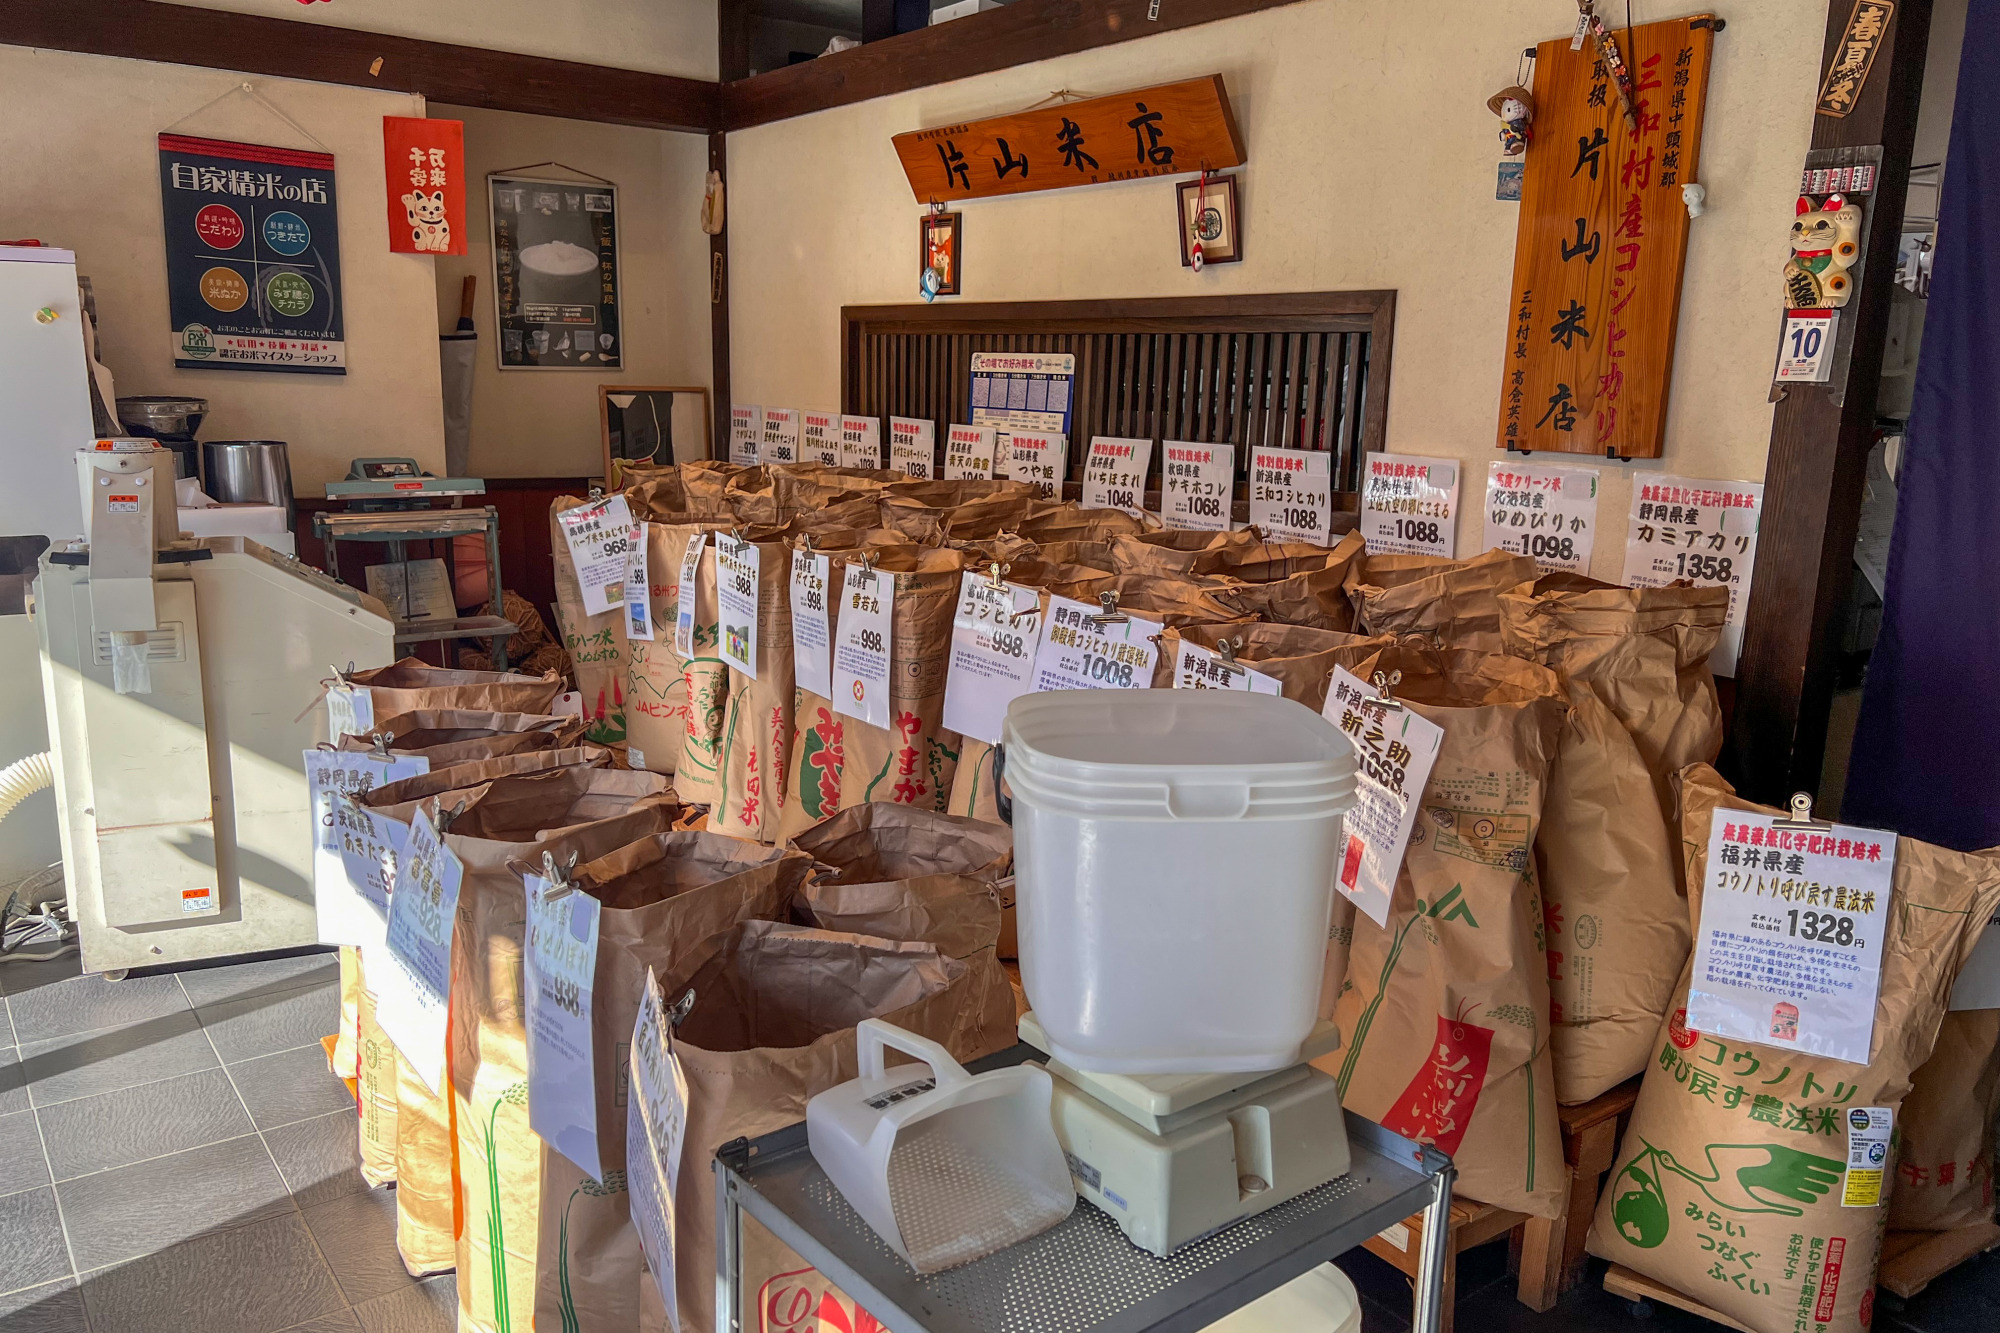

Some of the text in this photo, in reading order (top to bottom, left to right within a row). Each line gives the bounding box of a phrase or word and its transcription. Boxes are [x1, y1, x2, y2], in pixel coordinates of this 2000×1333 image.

[936, 101, 1176, 191] 片山米店
[171, 162, 327, 204] 自家精米の店
[200, 223, 241, 237] こだわり
[267, 230, 306, 243] つきたて
[1596, 53, 1662, 443] 三和村産コシヒカリ
[600, 226, 615, 305] ご飯一杯の値段
[1535, 127, 1609, 432] 片山米店
[209, 288, 242, 299] 米ぬか
[273, 288, 310, 300] みず穂の
[278, 300, 306, 310] チカラ
[1513, 290, 1533, 359] 三和村長
[236, 339, 319, 352] 信用 技術 対話
[1791, 327, 1822, 358] 10
[219, 348, 338, 364] 認定お米マイスターショップ
[980, 358, 1035, 370] その場でお好み精米
[805, 426, 823, 437] 山形県産
[743, 441, 756, 454] 978
[777, 446, 791, 460] 988
[821, 451, 835, 466] 998
[1012, 450, 1039, 463] 山形県産
[1093, 443, 1131, 456] 特別栽培米
[1168, 448, 1212, 463] 特別栽培米
[906, 461, 927, 479] 1038
[949, 454, 990, 471] 青天の霹靂
[1018, 465, 1054, 480] つや姫
[1090, 455, 1116, 470] 福井県産
[1168, 463, 1200, 479] 秋田県産
[1256, 454, 1304, 472] 特別栽培米
[1371, 461, 1428, 478] 特別栽培米
[1088, 470, 1140, 488] いちほまれ
[1168, 478, 1227, 497] サキホコレ
[1255, 469, 1292, 487] 新潟県産
[1107, 489, 1134, 509] 1048
[1187, 496, 1220, 518] 1068
[1255, 486, 1326, 509] 三和コシヒカリ
[1494, 489, 1545, 510] 北海道産
[1640, 484, 1755, 510] 無農薬無化学肥料栽培米
[1283, 507, 1318, 531] 1088
[1491, 508, 1587, 534] ゆめぴりか
[1638, 502, 1699, 526] 静岡県産
[1395, 519, 1439, 544] 1088
[1637, 523, 1751, 555] カミアカリ
[603, 538, 627, 557] 968
[1520, 533, 1574, 562] 1098
[1572, 553, 1580, 562] 円
[1676, 552, 1732, 583] 1358
[735, 574, 751, 598] 988
[795, 573, 823, 591] だて正夢
[1731, 575, 1740, 585] 円
[807, 590, 822, 611] 998
[852, 592, 880, 615] 雪若丸
[963, 601, 1037, 634] コシヒカリ
[1054, 606, 1108, 636] 静岡県産
[861, 628, 882, 653] 998
[991, 630, 1024, 658] 998
[1082, 653, 1134, 688] 1008
[1183, 652, 1232, 688] 新潟県産
[1335, 681, 1388, 727] 新潟県産
[1339, 707, 1413, 769] 新之助
[318, 767, 375, 789] 静岡県産
[1722, 822, 1882, 863] 無農薬無化学肥料栽培米
[1720, 843, 1805, 876] 福井県産
[1716, 871, 1876, 916] コウノトリ呼び戻す農法米
[418, 898, 442, 945] 928
[1750, 922, 1780, 933] 税込価格
[1786, 909, 1854, 947] 1328
[1853, 938, 1865, 950] 円
[554, 970, 580, 1019] 938
[1698, 1037, 1859, 1104] コウノトリ
[1659, 1041, 1842, 1138] 呼び戻す農法米
[1684, 1201, 1747, 1240] みらい
[1696, 1232, 1762, 1271] つなぐ
[1783, 1232, 1805, 1281] お米です
[1706, 1261, 1771, 1298] ふくい
[1793, 1236, 1825, 1333] 使わずに栽培され
